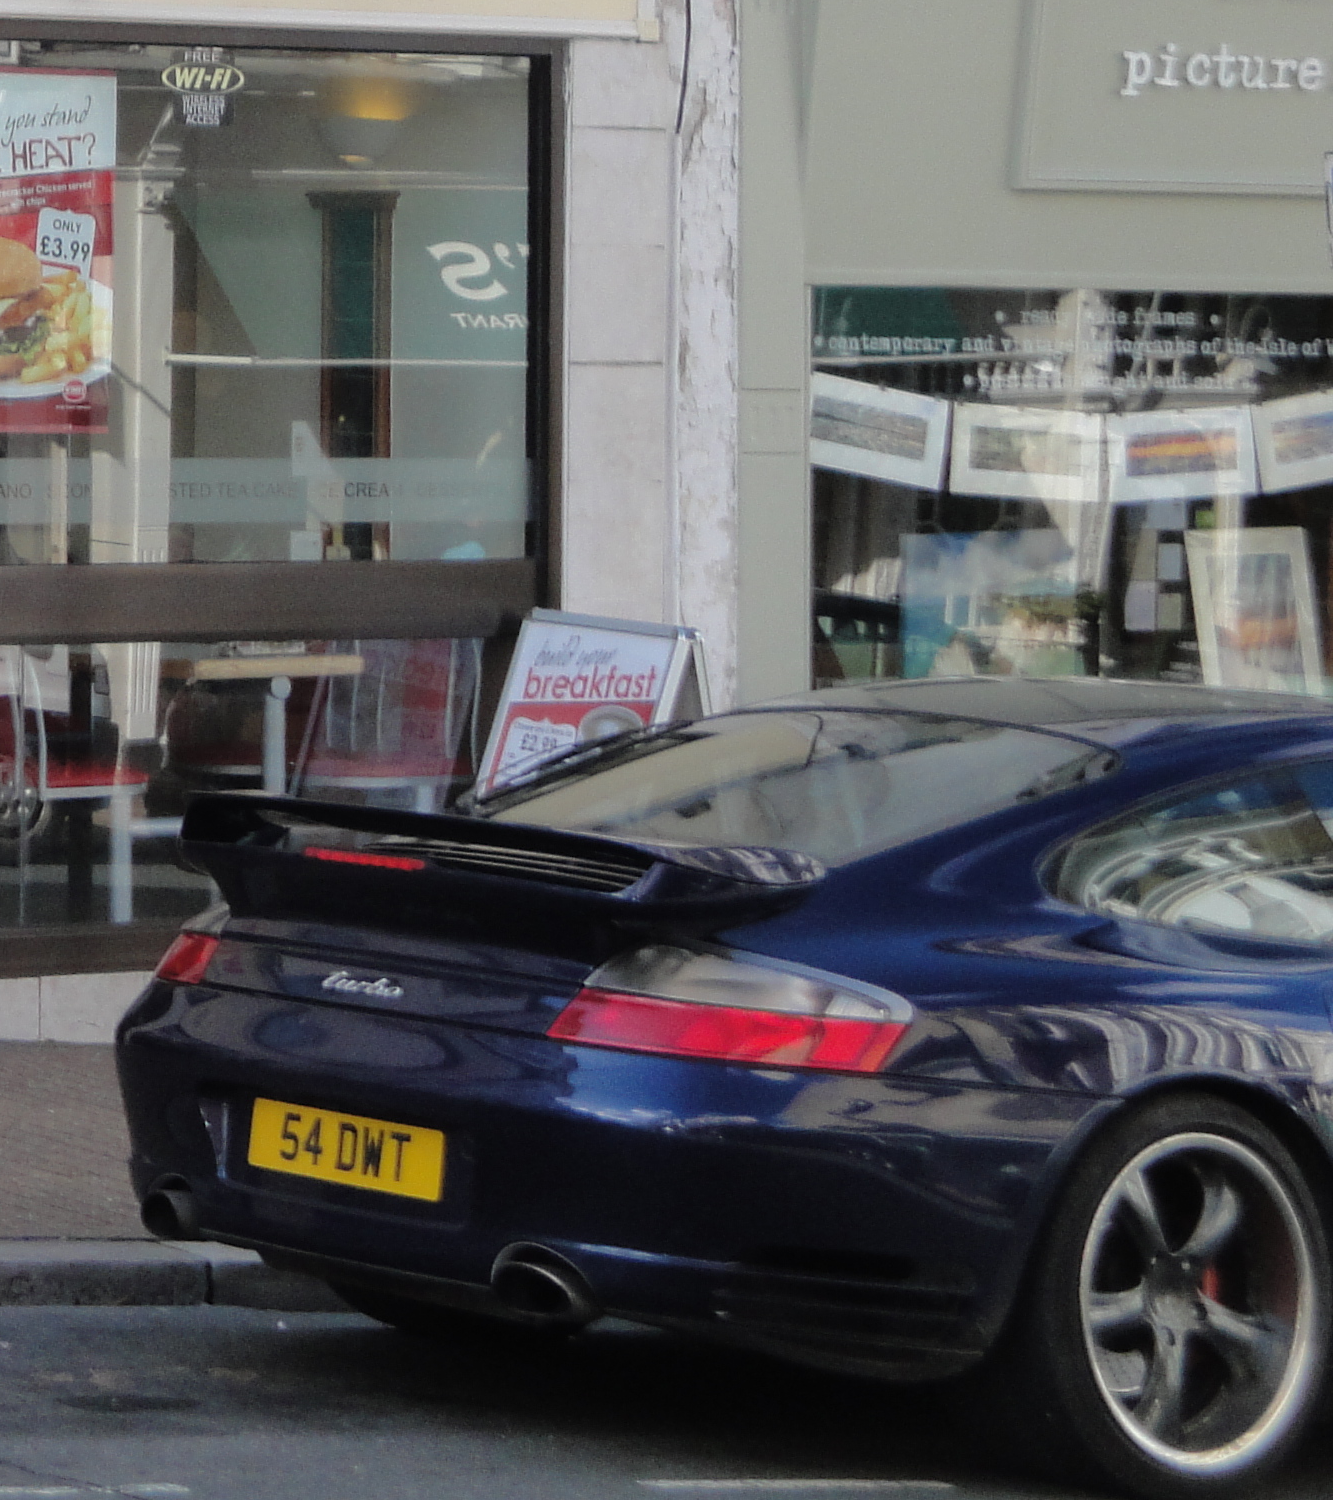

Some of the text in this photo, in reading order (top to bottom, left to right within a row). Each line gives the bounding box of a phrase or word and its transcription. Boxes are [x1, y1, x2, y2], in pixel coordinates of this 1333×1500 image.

[184, 50, 220, 62] FREE
[174, 66, 232, 90] WI-FI
[1121, 43, 1324, 96] picture
[181, 94, 225, 104] WIRELESS
[182, 104, 225, 115] INTERNET
[1, 112, 36, 146] you
[41, 95, 92, 127] stand
[185, 114, 221, 126] ACCESS
[11, 132, 96, 173] HEAT?
[36, 183, 67, 194] Chicken
[52, 218, 82, 233] ONLY
[40, 235, 91, 262] £3.99
[827, 332, 957, 356] contemporary
[961, 334, 995, 352] and
[1199, 337, 1223, 354] of
[1301, 337, 1322, 356] of
[522, 664, 657, 700] breakfast
[321, 970, 405, 998] turbo
[278, 1112, 412, 1183] 54 DWT
